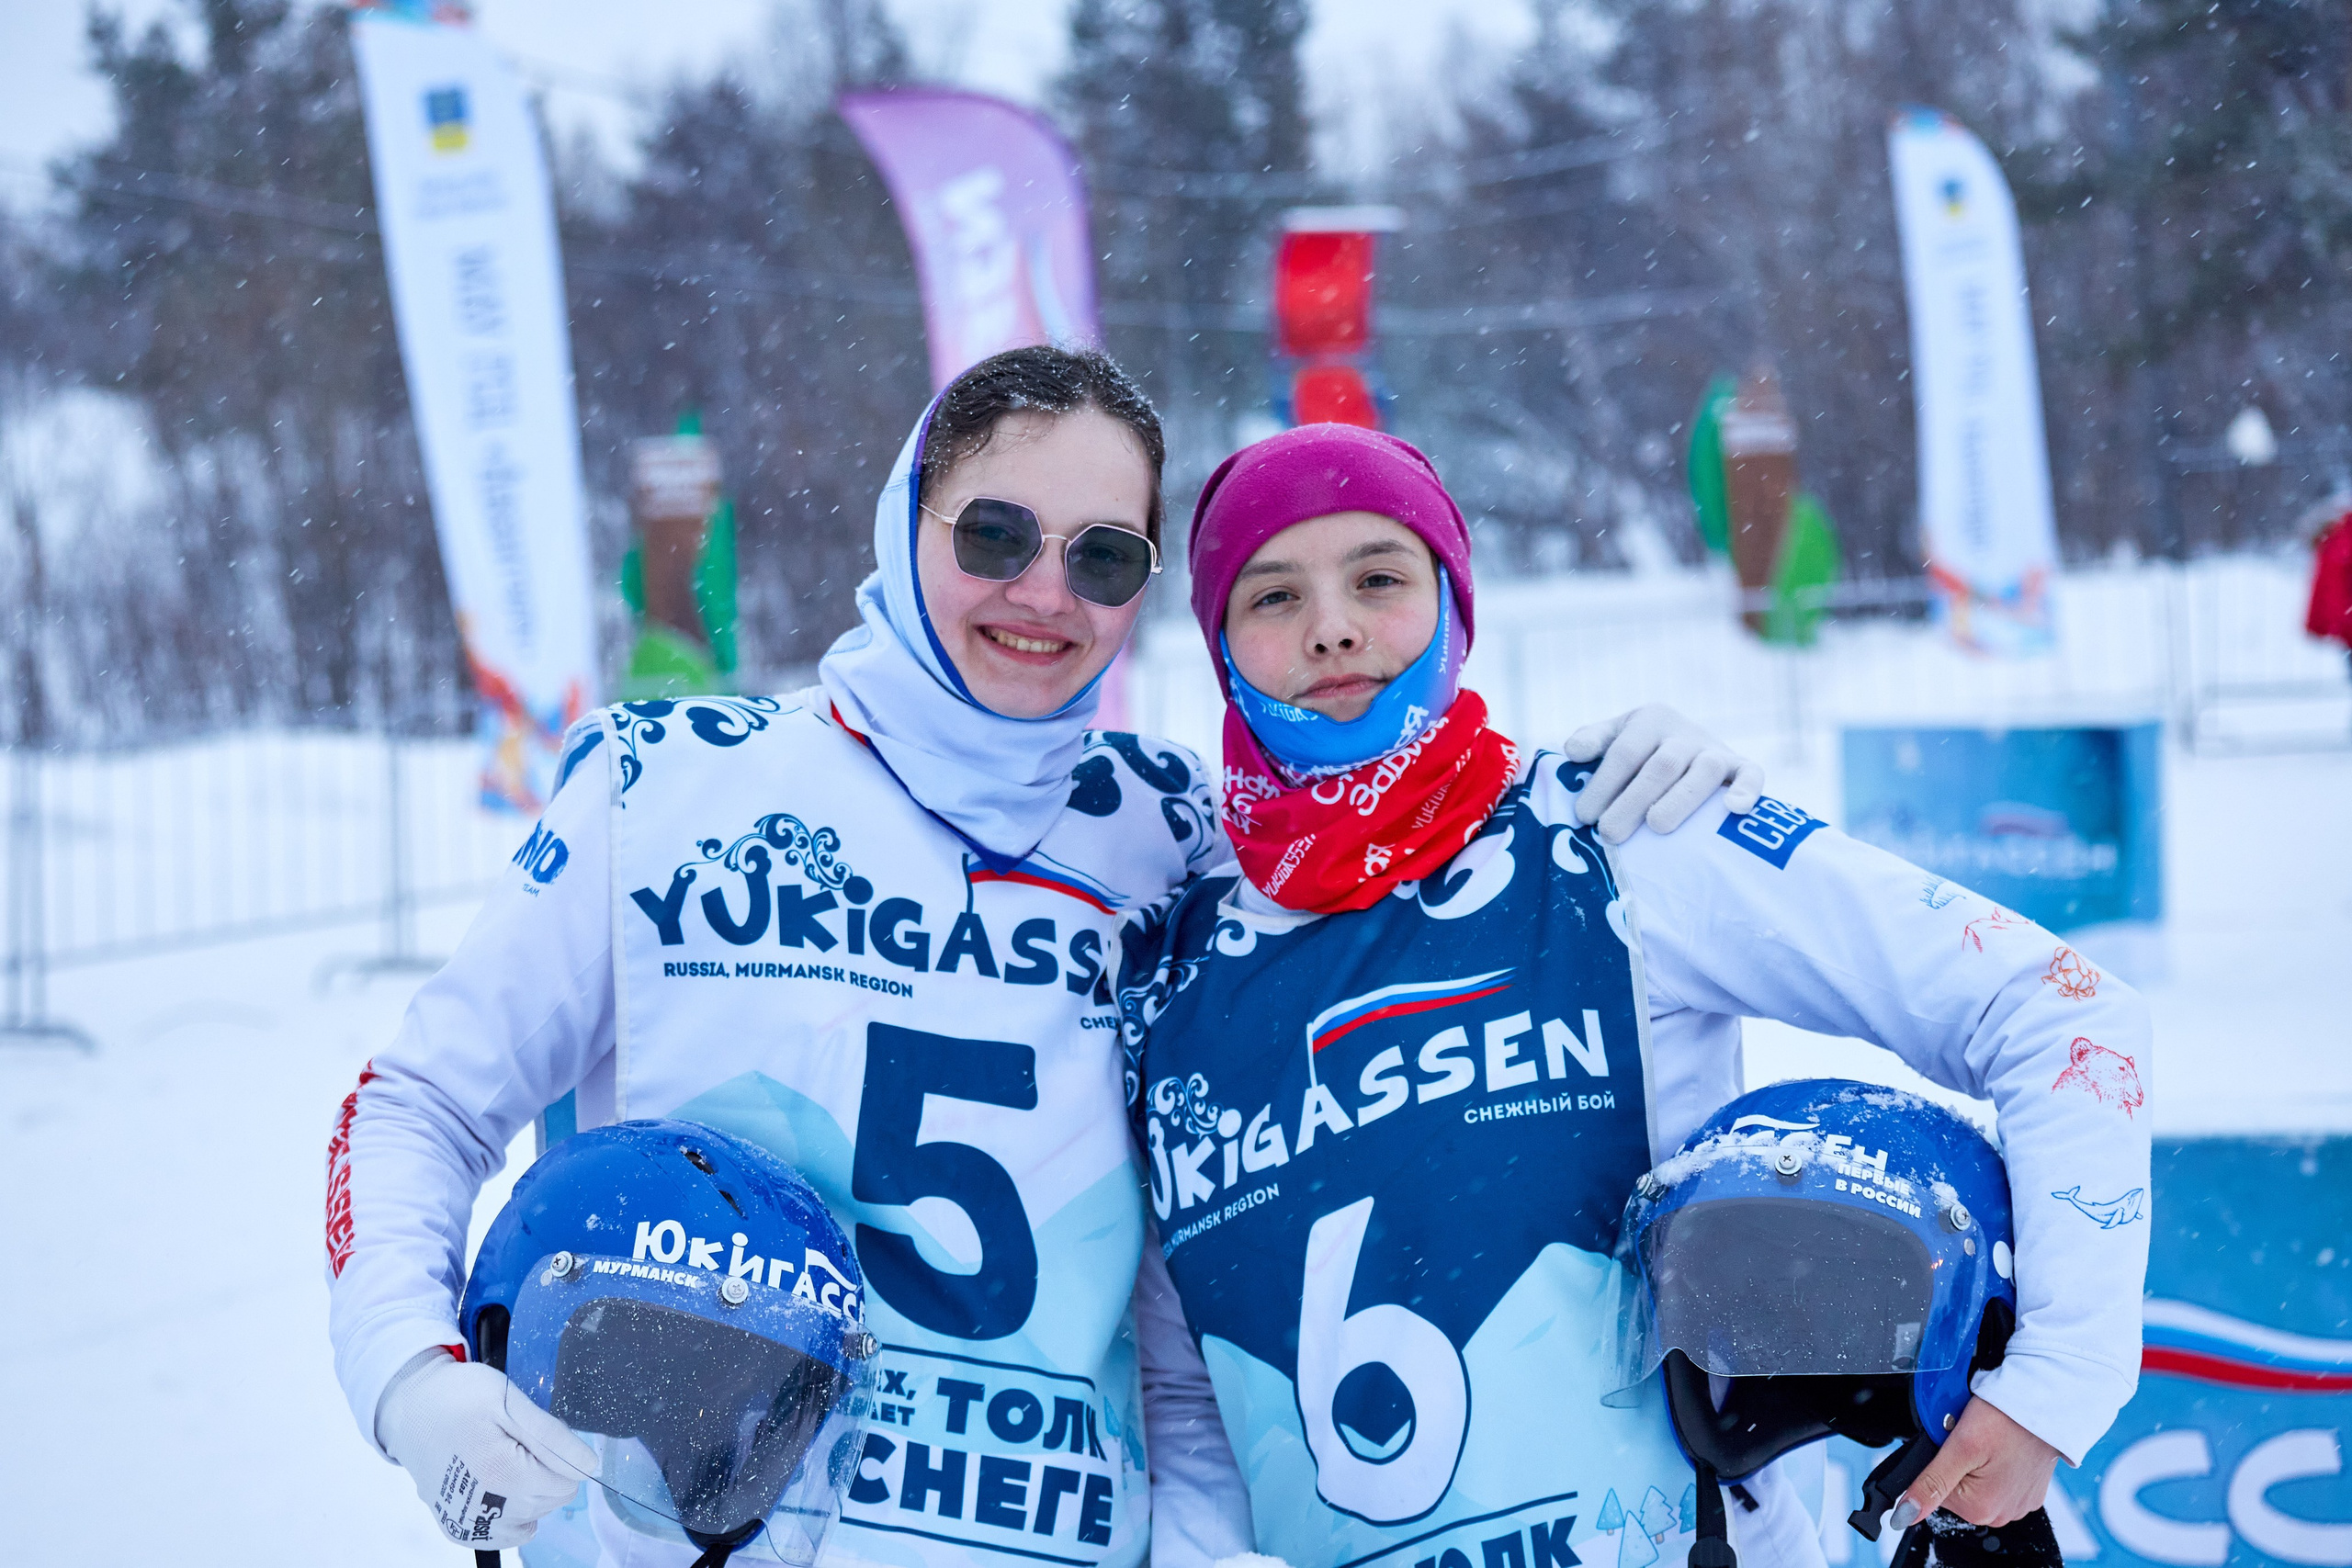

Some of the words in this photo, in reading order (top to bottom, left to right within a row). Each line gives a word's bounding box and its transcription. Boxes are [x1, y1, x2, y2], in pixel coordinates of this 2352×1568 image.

[1737, 798, 1814, 851] СЕВ
[663, 962, 730, 980] RUSSIA,
[734, 962, 845, 984] MURMANSK
[849, 973, 913, 999] REGION
[1080, 1015, 1119, 1031] СНЕ
[1464, 1093, 1572, 1124] СНЕЖНЫЙ
[1577, 1089, 1616, 1111] БОЙ
[851, 1021, 1039, 1341] 5
[1837, 1163, 1911, 1196] ПЕРВЫЕ
[1224, 1182, 1280, 1222] REGION
[1835, 1179, 1848, 1192] В
[1849, 1181, 1922, 1219] РОССИИ
[592, 1259, 699, 1289] МУРМАНСК
[1297, 1195, 1471, 1528] 6
[458, 1469, 470, 1495] Atlas
[834, 1433, 1114, 1547] СНЕГЕ
